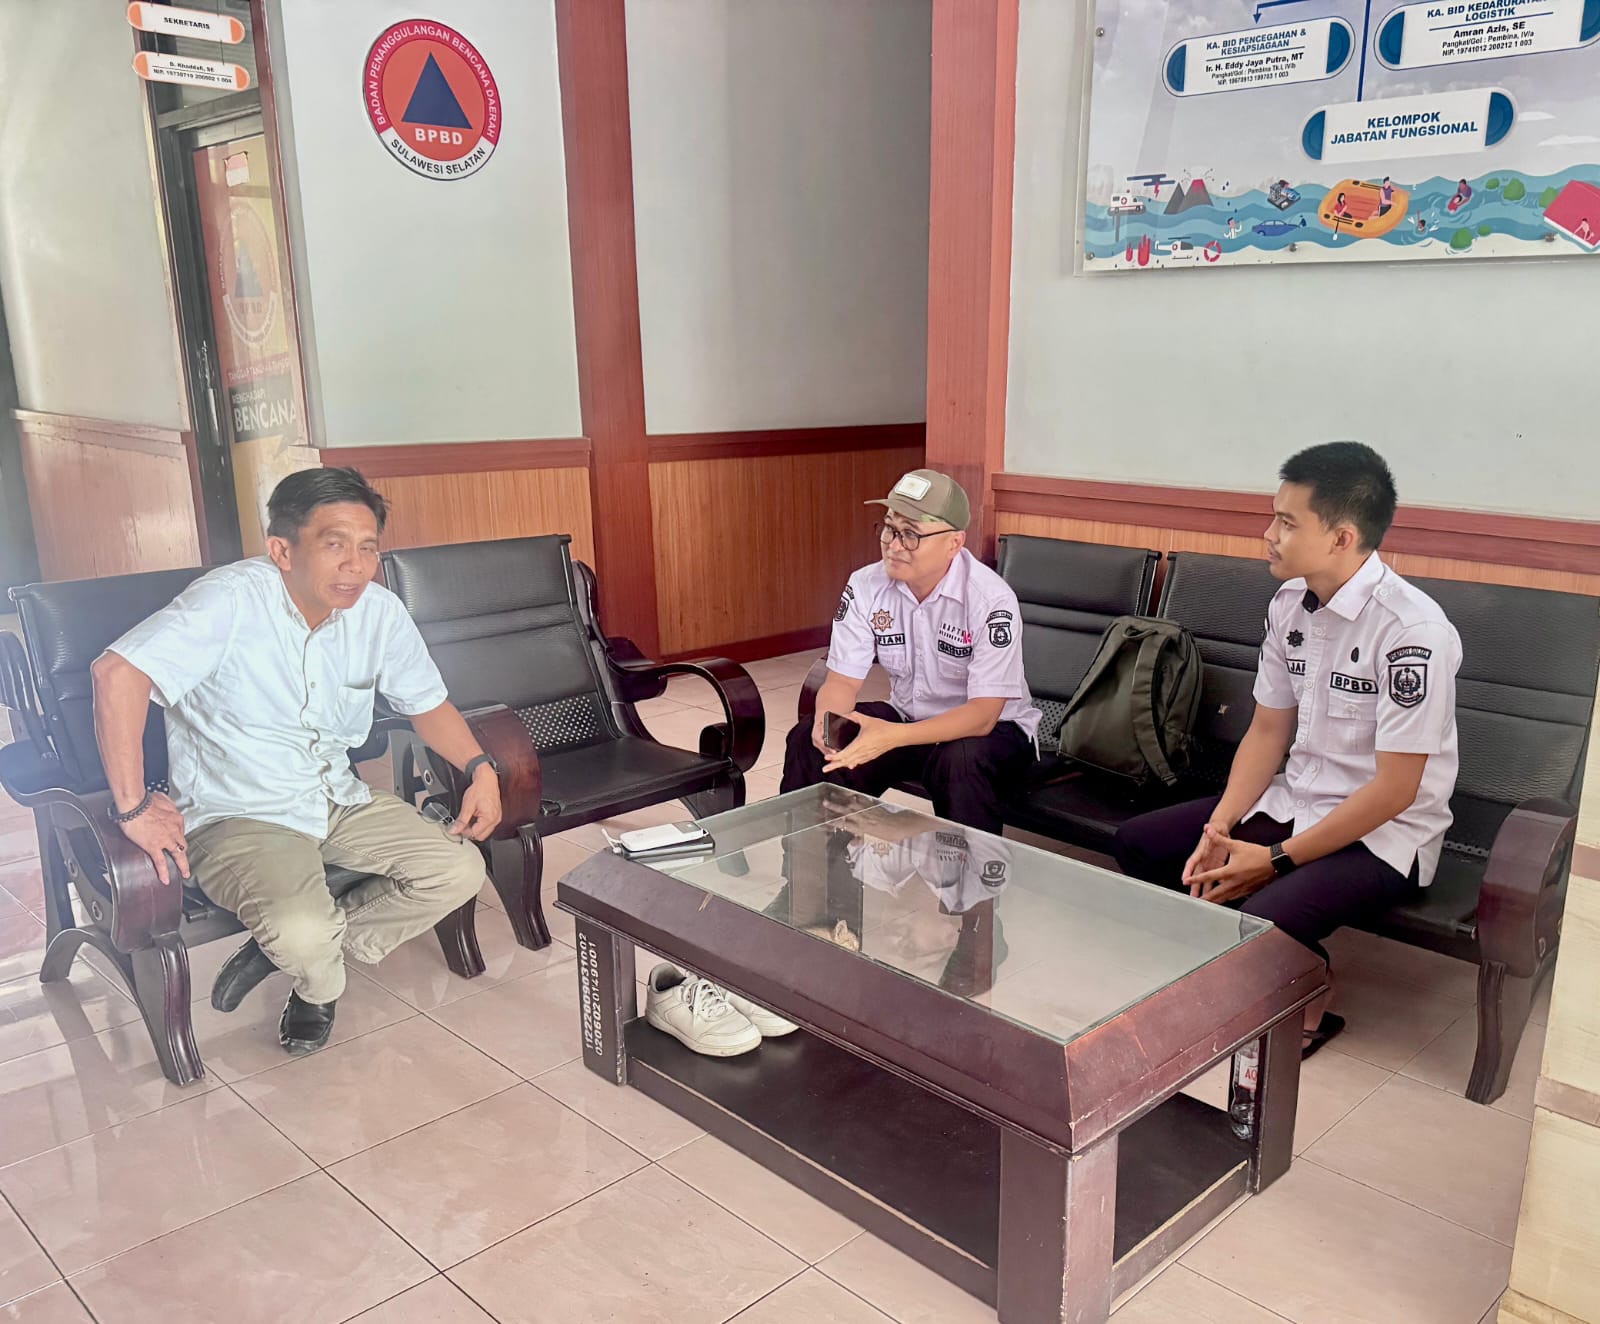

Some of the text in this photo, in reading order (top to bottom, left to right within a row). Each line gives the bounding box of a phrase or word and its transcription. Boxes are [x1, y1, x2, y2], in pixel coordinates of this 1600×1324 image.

[1427, 0, 1547, 18] KA. BID KEDARURA
[1465, 7, 1515, 22] LOGISTIK
[164, 17, 210, 29] SEKRETARIS
[1453, 21, 1526, 38] Amran Azis, SE
[1206, 28, 1307, 50] KA. BID PENCEGAHAN &
[1220, 39, 1290, 56] KESIAPSIAGAAN
[1205, 52, 1305, 73] Ir. H. Eddy Jaya Putra, MT
[369, 25, 498, 139] BADAN PENANGGULANGAN BENCANA DAERAH
[1367, 111, 1441, 129] KELOMPOK
[414, 127, 464, 145] BPBD
[1330, 121, 1479, 146] JABATAN FUNGSIONAL
[391, 139, 486, 175] SULAWESI SELATAN
[234, 399, 297, 432] BENCANA
[1334, 675, 1373, 692] BPBD
